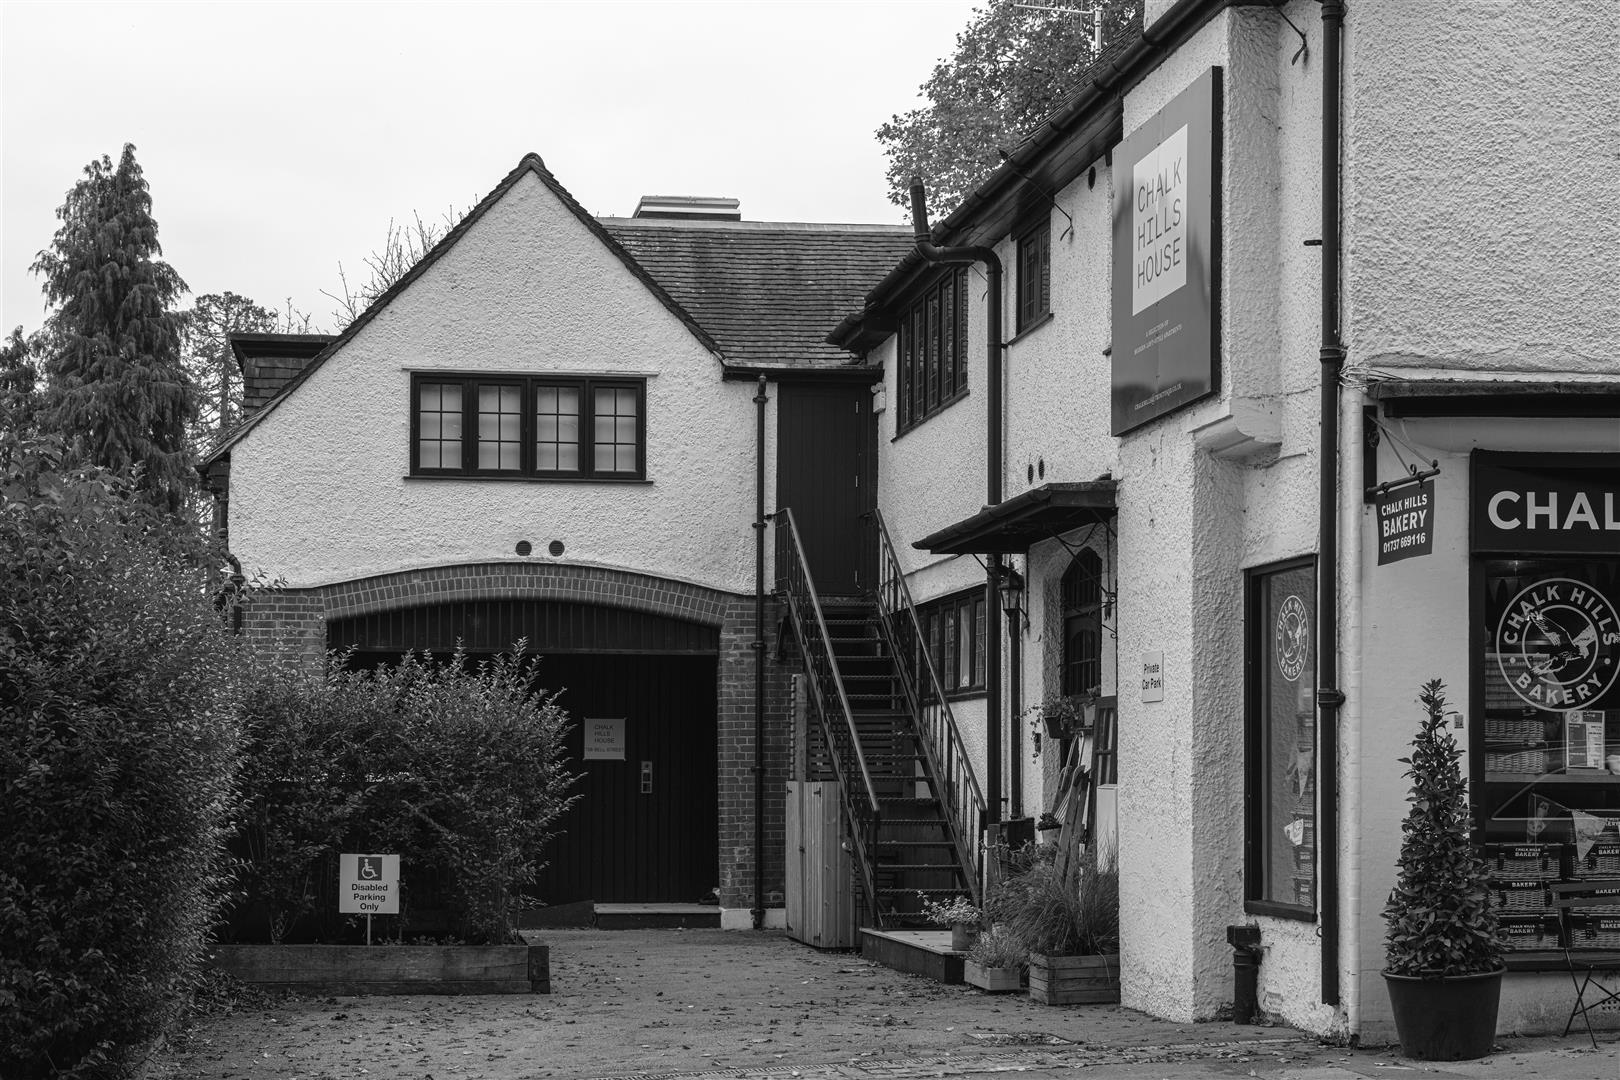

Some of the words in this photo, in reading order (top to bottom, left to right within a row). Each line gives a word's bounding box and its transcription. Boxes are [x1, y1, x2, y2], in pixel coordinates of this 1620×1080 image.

[1137, 157, 1182, 212] CHALK
[1137, 198, 1181, 252] HILLS
[1137, 237, 1181, 289] HOUSE
[1381, 500, 1403, 517] CHALK
[1404, 494, 1428, 510] HILLS
[1488, 490, 1620, 531] CHAL
[1383, 509, 1427, 538] BAKERY
[1383, 538, 1400, 553] 01737
[1400, 532, 1426, 548] 669116
[1277, 600, 1293, 640] CHALK
[1503, 585, 1561, 645] CHALK
[1569, 587, 1617, 646] HILLS
[1280, 657, 1304, 677] BAKERY
[1515, 671, 1602, 705] BAKERY
[351, 883, 388, 892] Disabled
[353, 893, 386, 903] Parking
[360, 902, 380, 912] Only
